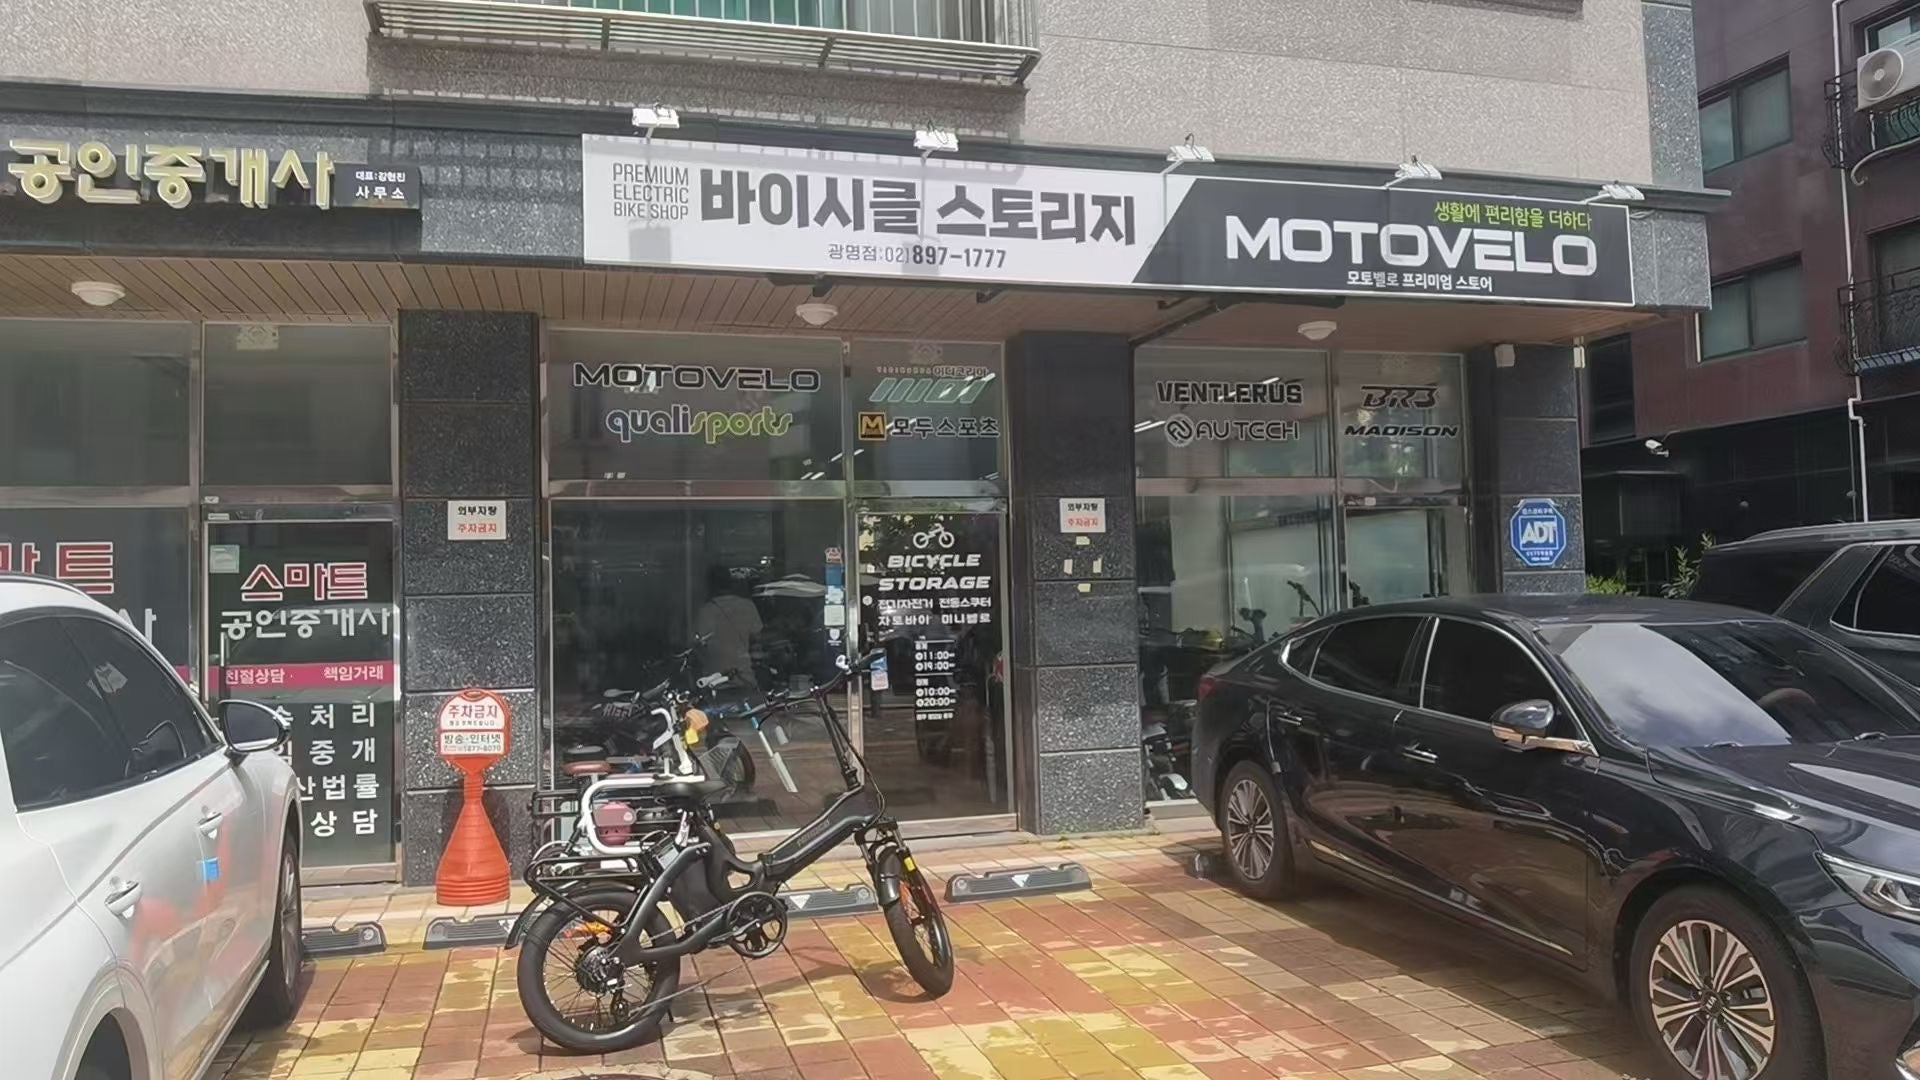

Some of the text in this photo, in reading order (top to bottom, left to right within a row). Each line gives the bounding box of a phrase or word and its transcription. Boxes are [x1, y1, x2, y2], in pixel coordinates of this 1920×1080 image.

[8, 139, 335, 210] 공인중개사
[613, 163, 689, 186] PREMIUM
[355, 185, 405, 200] 사무소
[613, 183, 689, 205] ELECTRIC
[614, 202, 689, 220] BIKE SHOP
[700, 168, 1136, 245] 바이시클 스토리지
[1435, 202, 1592, 232] 생활에 편리함을 더하다
[1225, 215, 1597, 277] MOTOVELO
[1347, 270, 1493, 293] 모토벨로 프리미엄 스토어
[574, 363, 820, 392] MOTOVELO
[1156, 380, 1303, 405] VENTLERUS
[606, 404, 793, 444] qualisports
[891, 416, 1000, 440] 모두스포츠
[1344, 424, 1459, 439] MADISON
[1521, 520, 1556, 545] ADT
[887, 554, 981, 568] BICYCLE
[240, 562, 368, 601] 스마트
[878, 576, 991, 591] STORAGE
[221, 607, 391, 640] 공인중개사
[226, 665, 384, 685] 친절상담 책임거래
[448, 704, 498, 719] 주차금지
